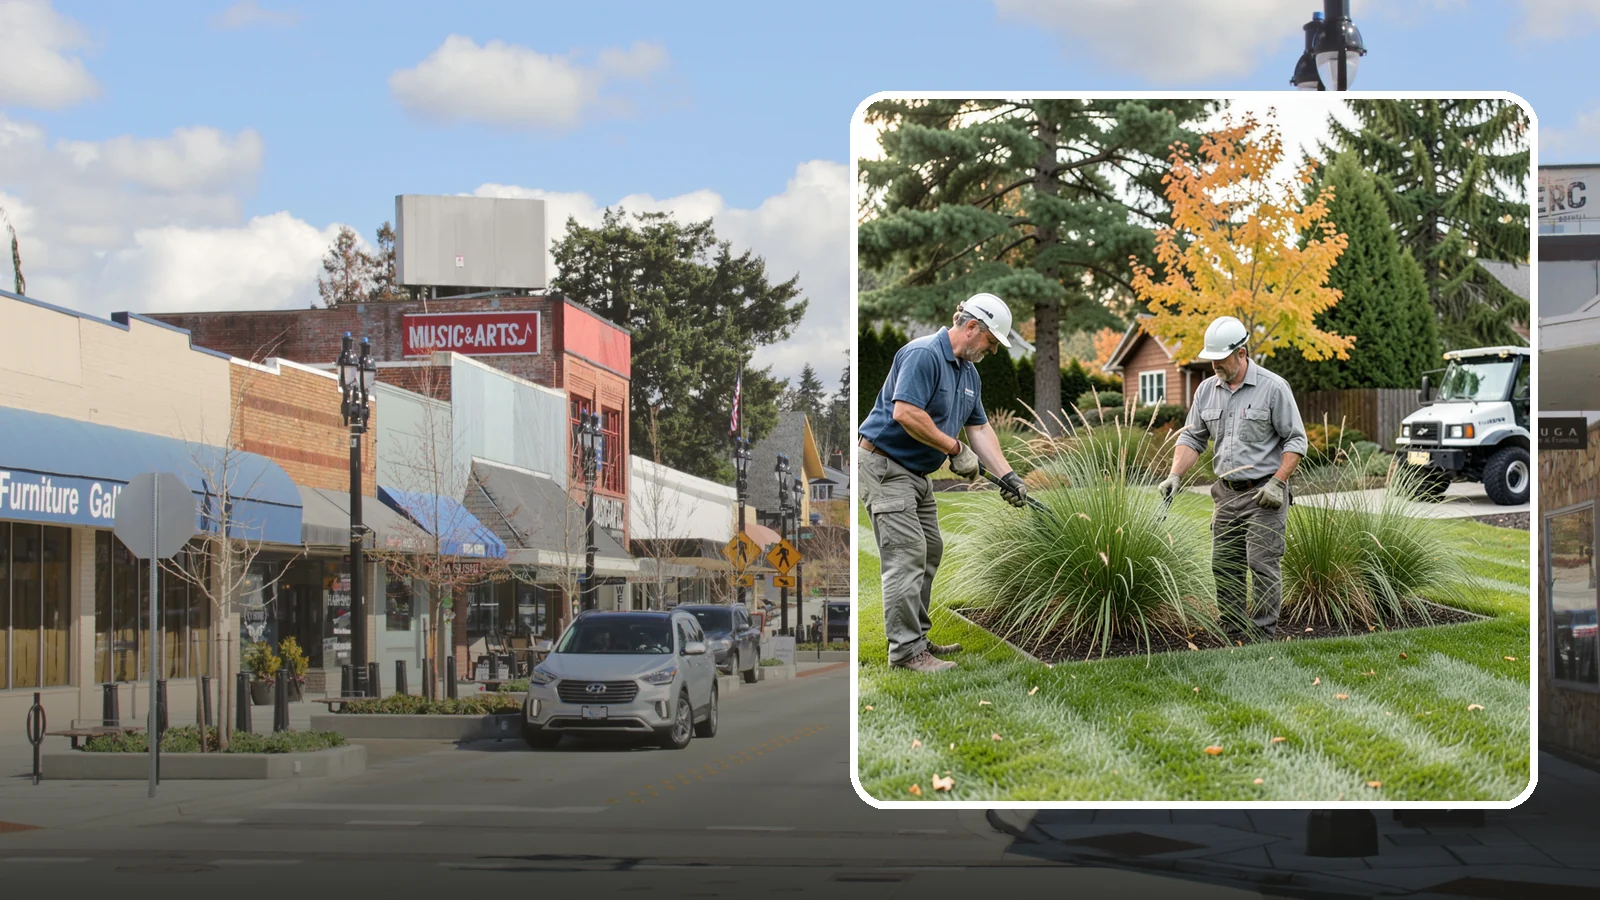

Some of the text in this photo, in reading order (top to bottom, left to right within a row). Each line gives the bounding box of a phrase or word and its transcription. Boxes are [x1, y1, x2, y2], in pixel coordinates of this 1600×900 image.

[408, 322, 520, 349] MUSIC&ARTS
[1540, 427, 1577, 436] UGA
[0, 471, 122, 519] Furniture Gal
